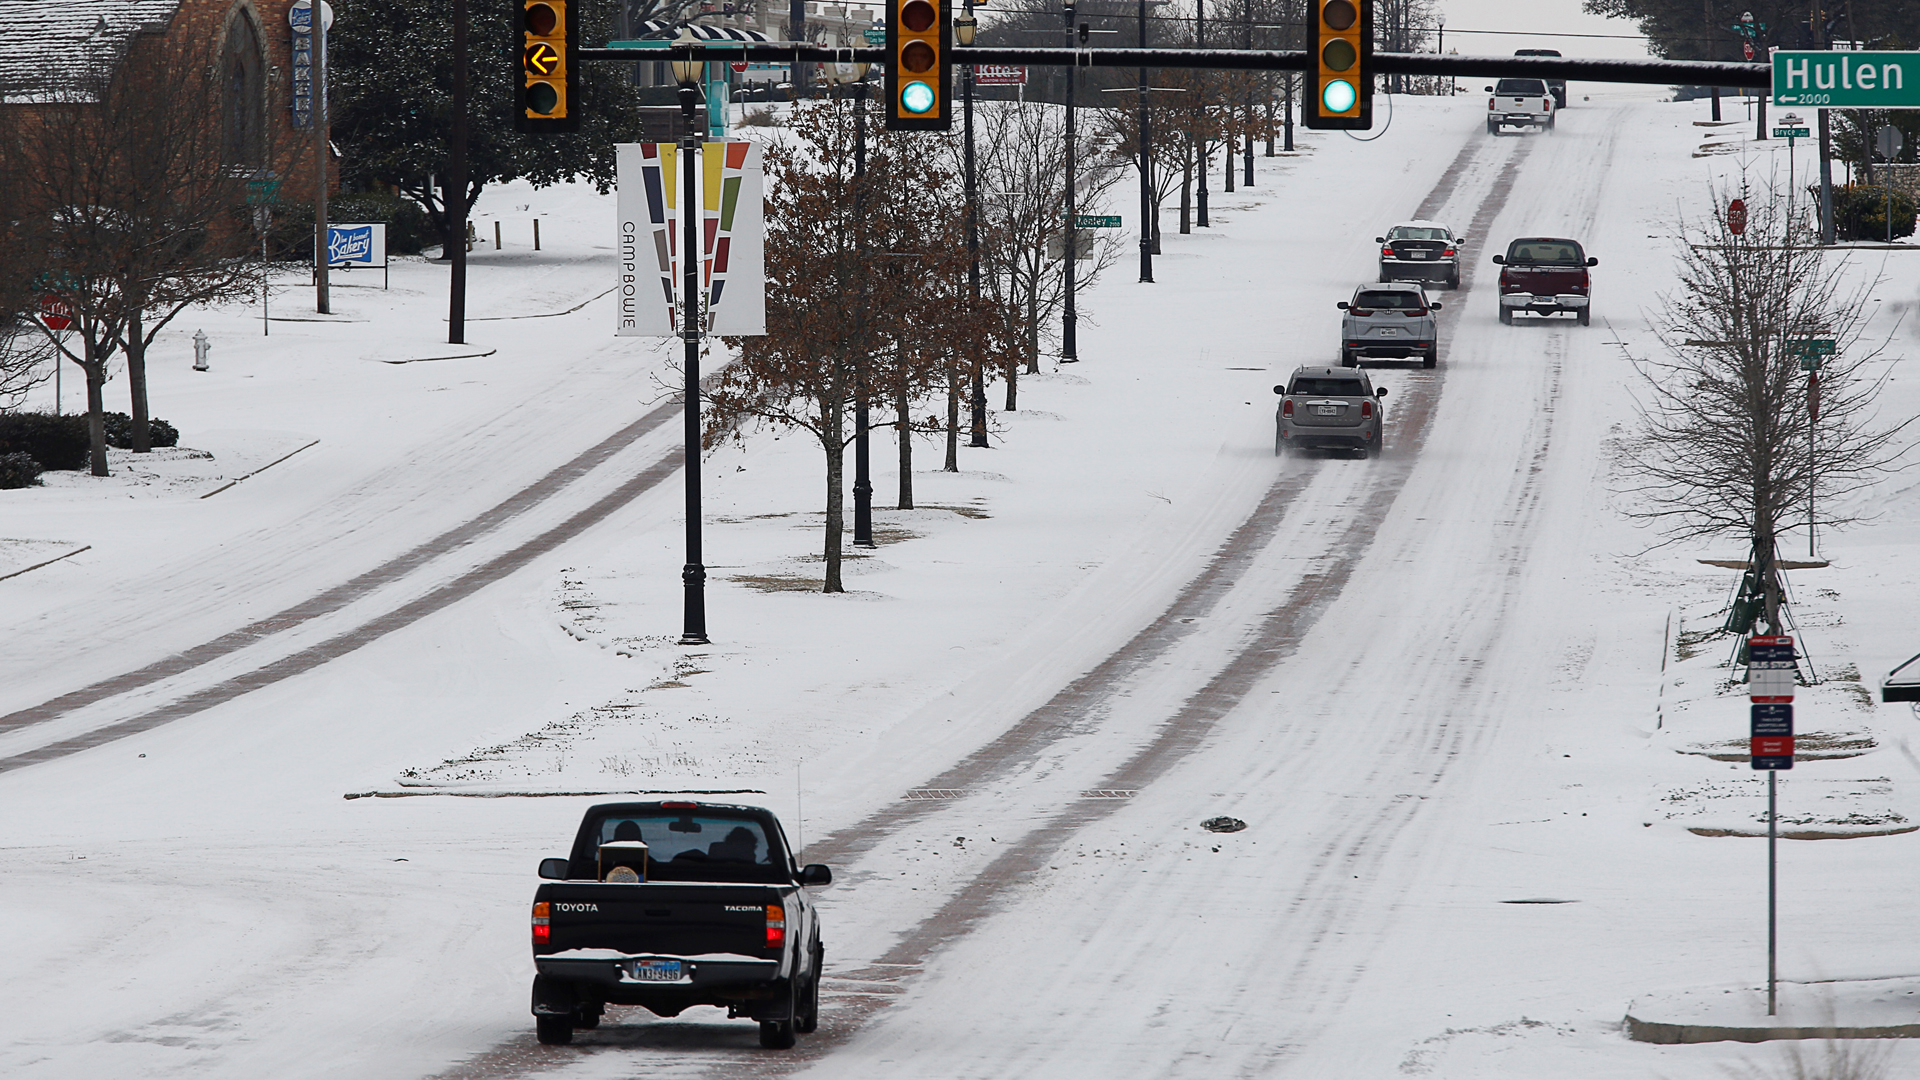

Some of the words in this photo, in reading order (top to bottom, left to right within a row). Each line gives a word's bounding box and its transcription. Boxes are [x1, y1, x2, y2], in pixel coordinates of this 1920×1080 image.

[1787, 56, 1903, 90] Hulen
[295, 37, 310, 126] BAKERY
[1799, 94, 1830, 104] 2000
[1078, 217, 1107, 227] Kenley
[328, 230, 370, 262] Bakery
[1751, 661, 1769, 669] BUS
[1770, 661, 1794, 669] STOP
[555, 903, 598, 912] TOYOTA
